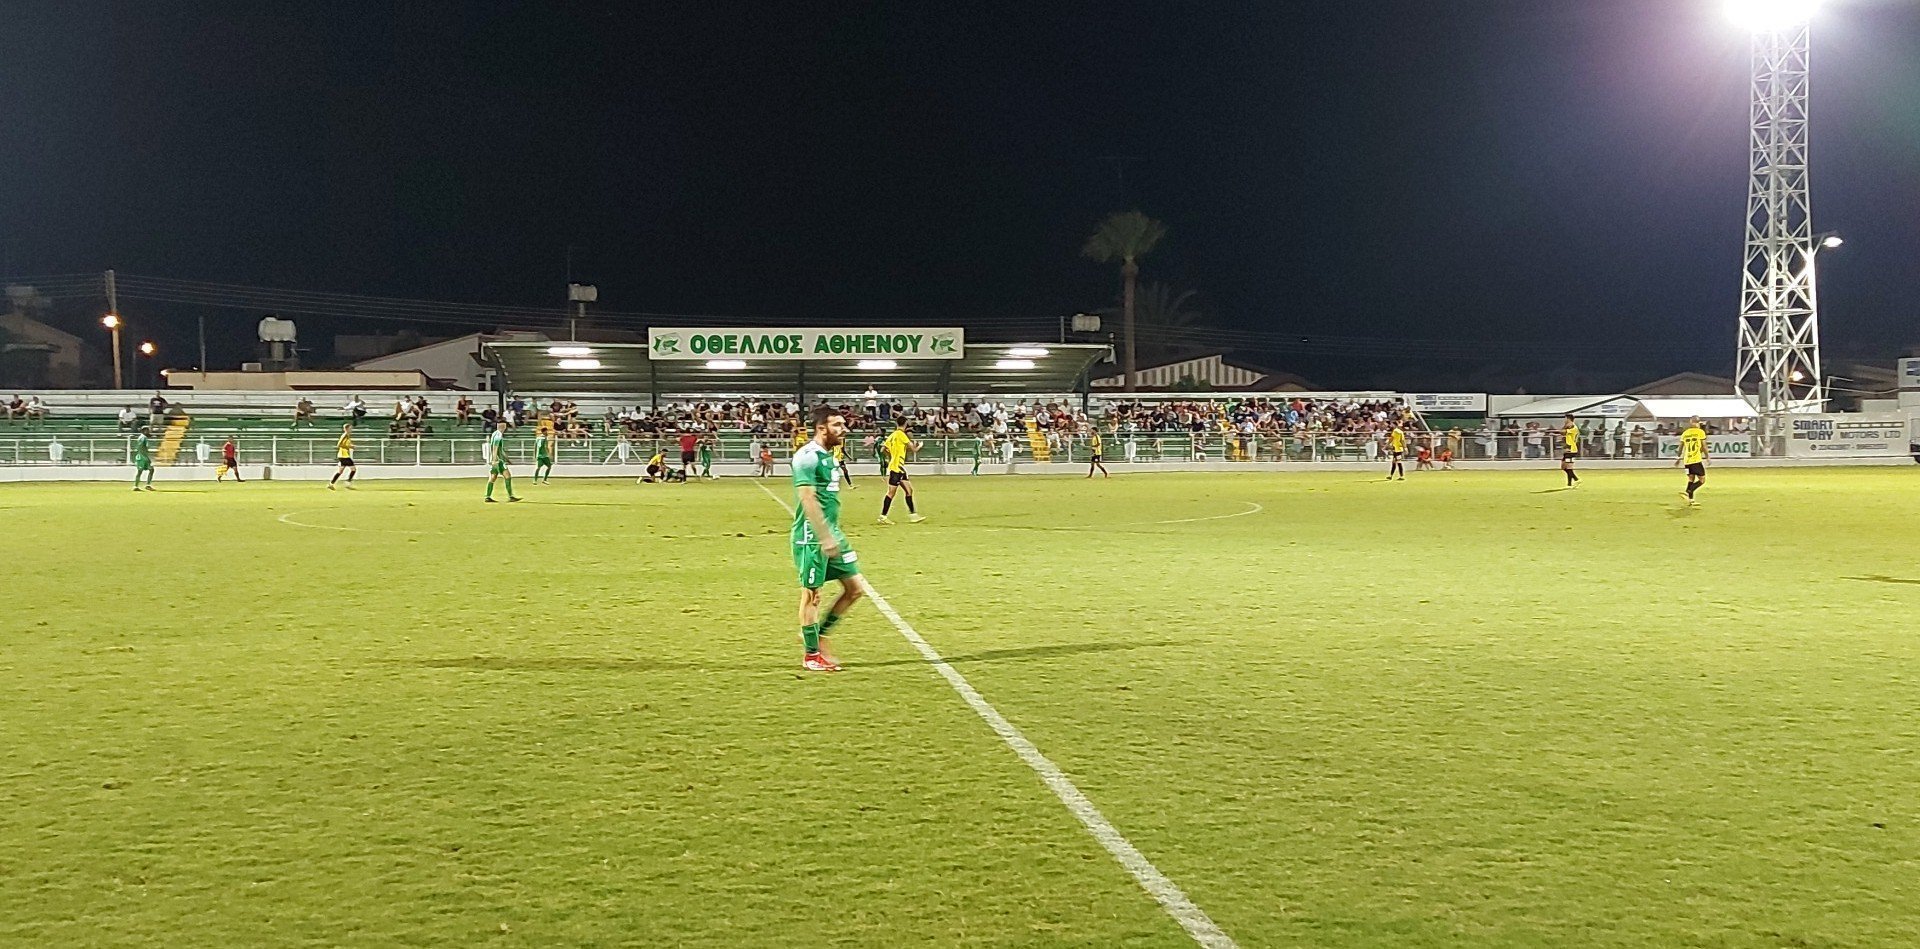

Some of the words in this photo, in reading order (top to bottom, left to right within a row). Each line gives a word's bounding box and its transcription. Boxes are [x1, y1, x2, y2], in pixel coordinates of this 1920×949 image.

[689, 334, 804, 354] ΟΘΕΛΛΟΣ
[814, 334, 923, 354] ΑΘΗΕΝΟΥ
[1793, 420, 1834, 430] SMART
[1806, 430, 1834, 440] WAY
[1840, 431, 1880, 439] MOTORS
[1706, 442, 1749, 453] ΕΛΛΟΣ
[808, 568, 816, 585] 5
